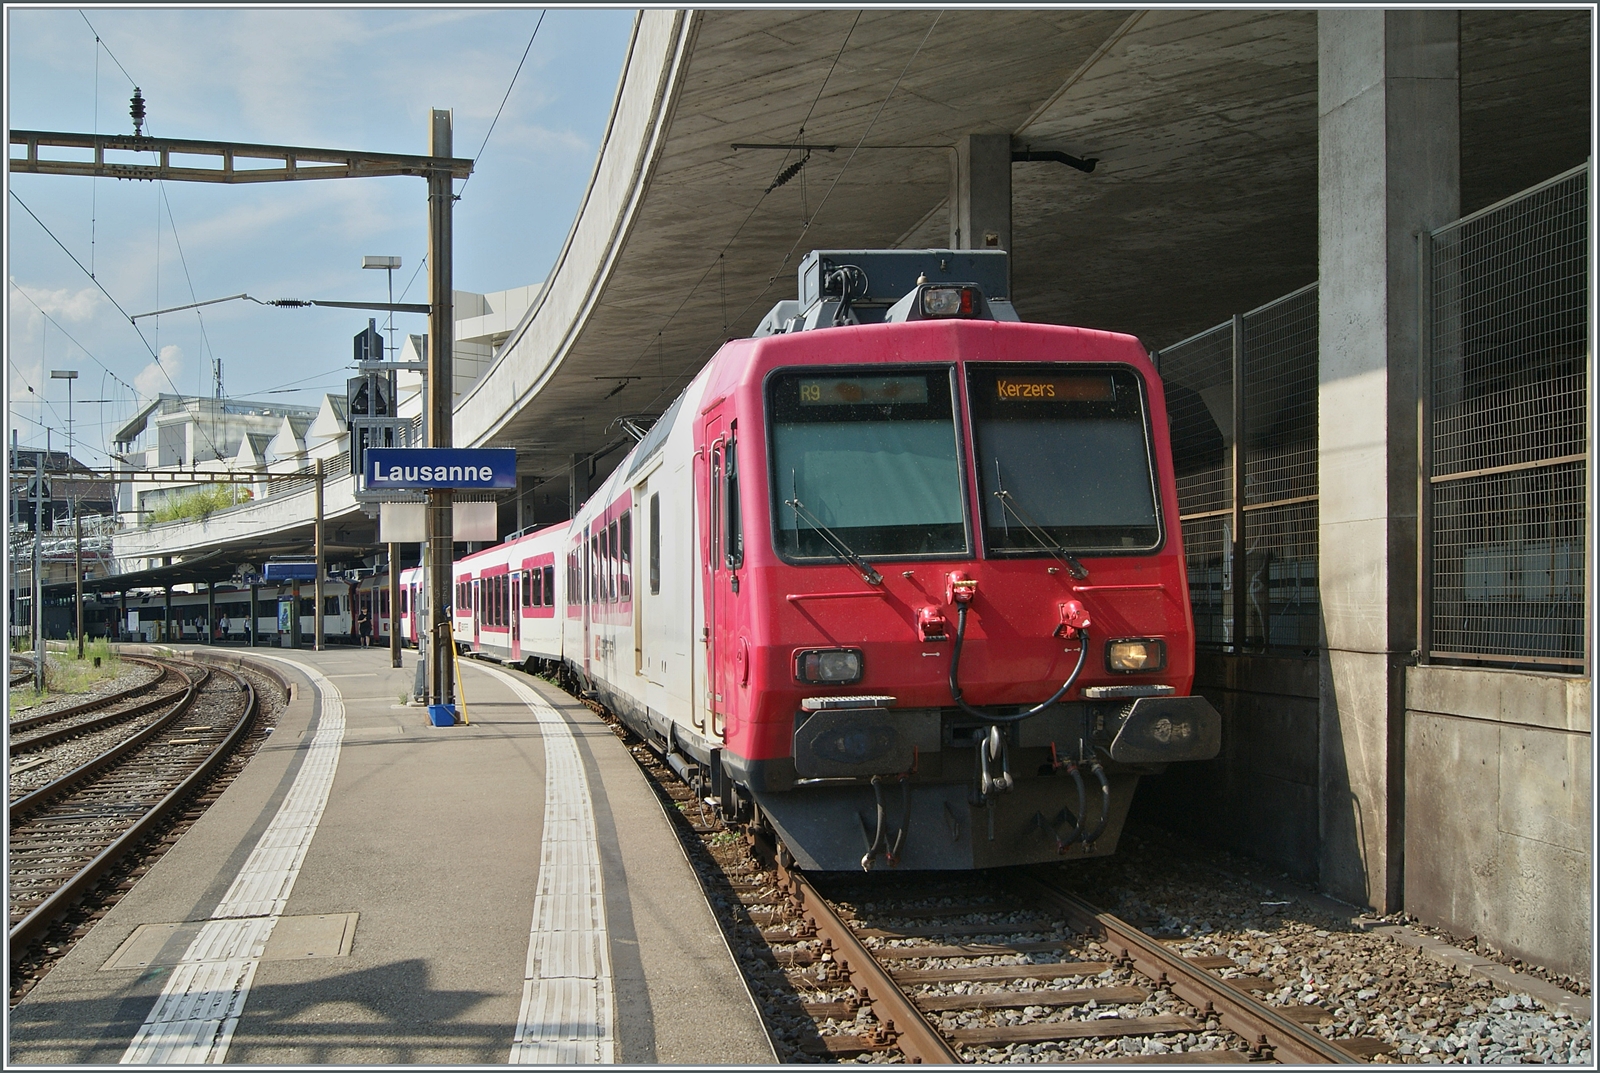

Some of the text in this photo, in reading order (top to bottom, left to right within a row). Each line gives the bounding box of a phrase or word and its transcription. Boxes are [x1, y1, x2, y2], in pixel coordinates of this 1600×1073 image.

[801, 385, 820, 401] R9
[997, 380, 1055, 397] Kerzers
[374, 461, 493, 482] Lausanne
